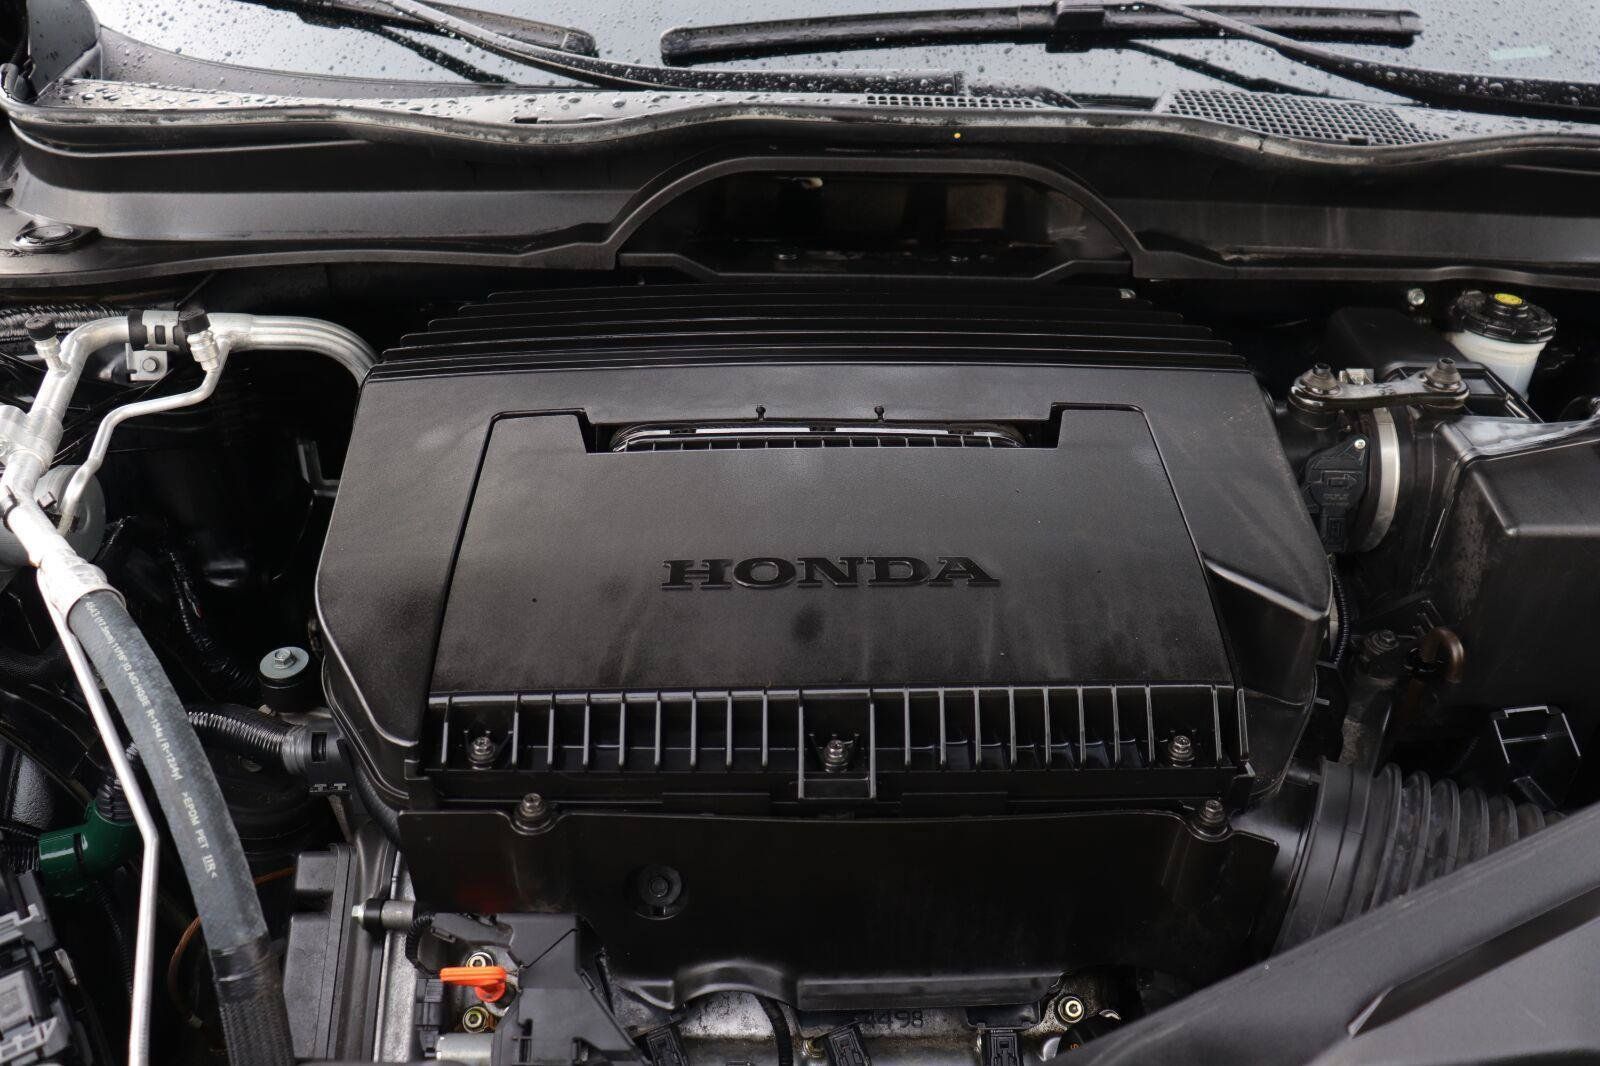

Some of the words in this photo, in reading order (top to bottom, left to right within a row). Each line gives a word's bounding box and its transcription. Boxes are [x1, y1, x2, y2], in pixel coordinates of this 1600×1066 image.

[661, 556, 1000, 590] HONDA
[134, 684, 151, 707] HOSE
[195, 828, 210, 850] PET
